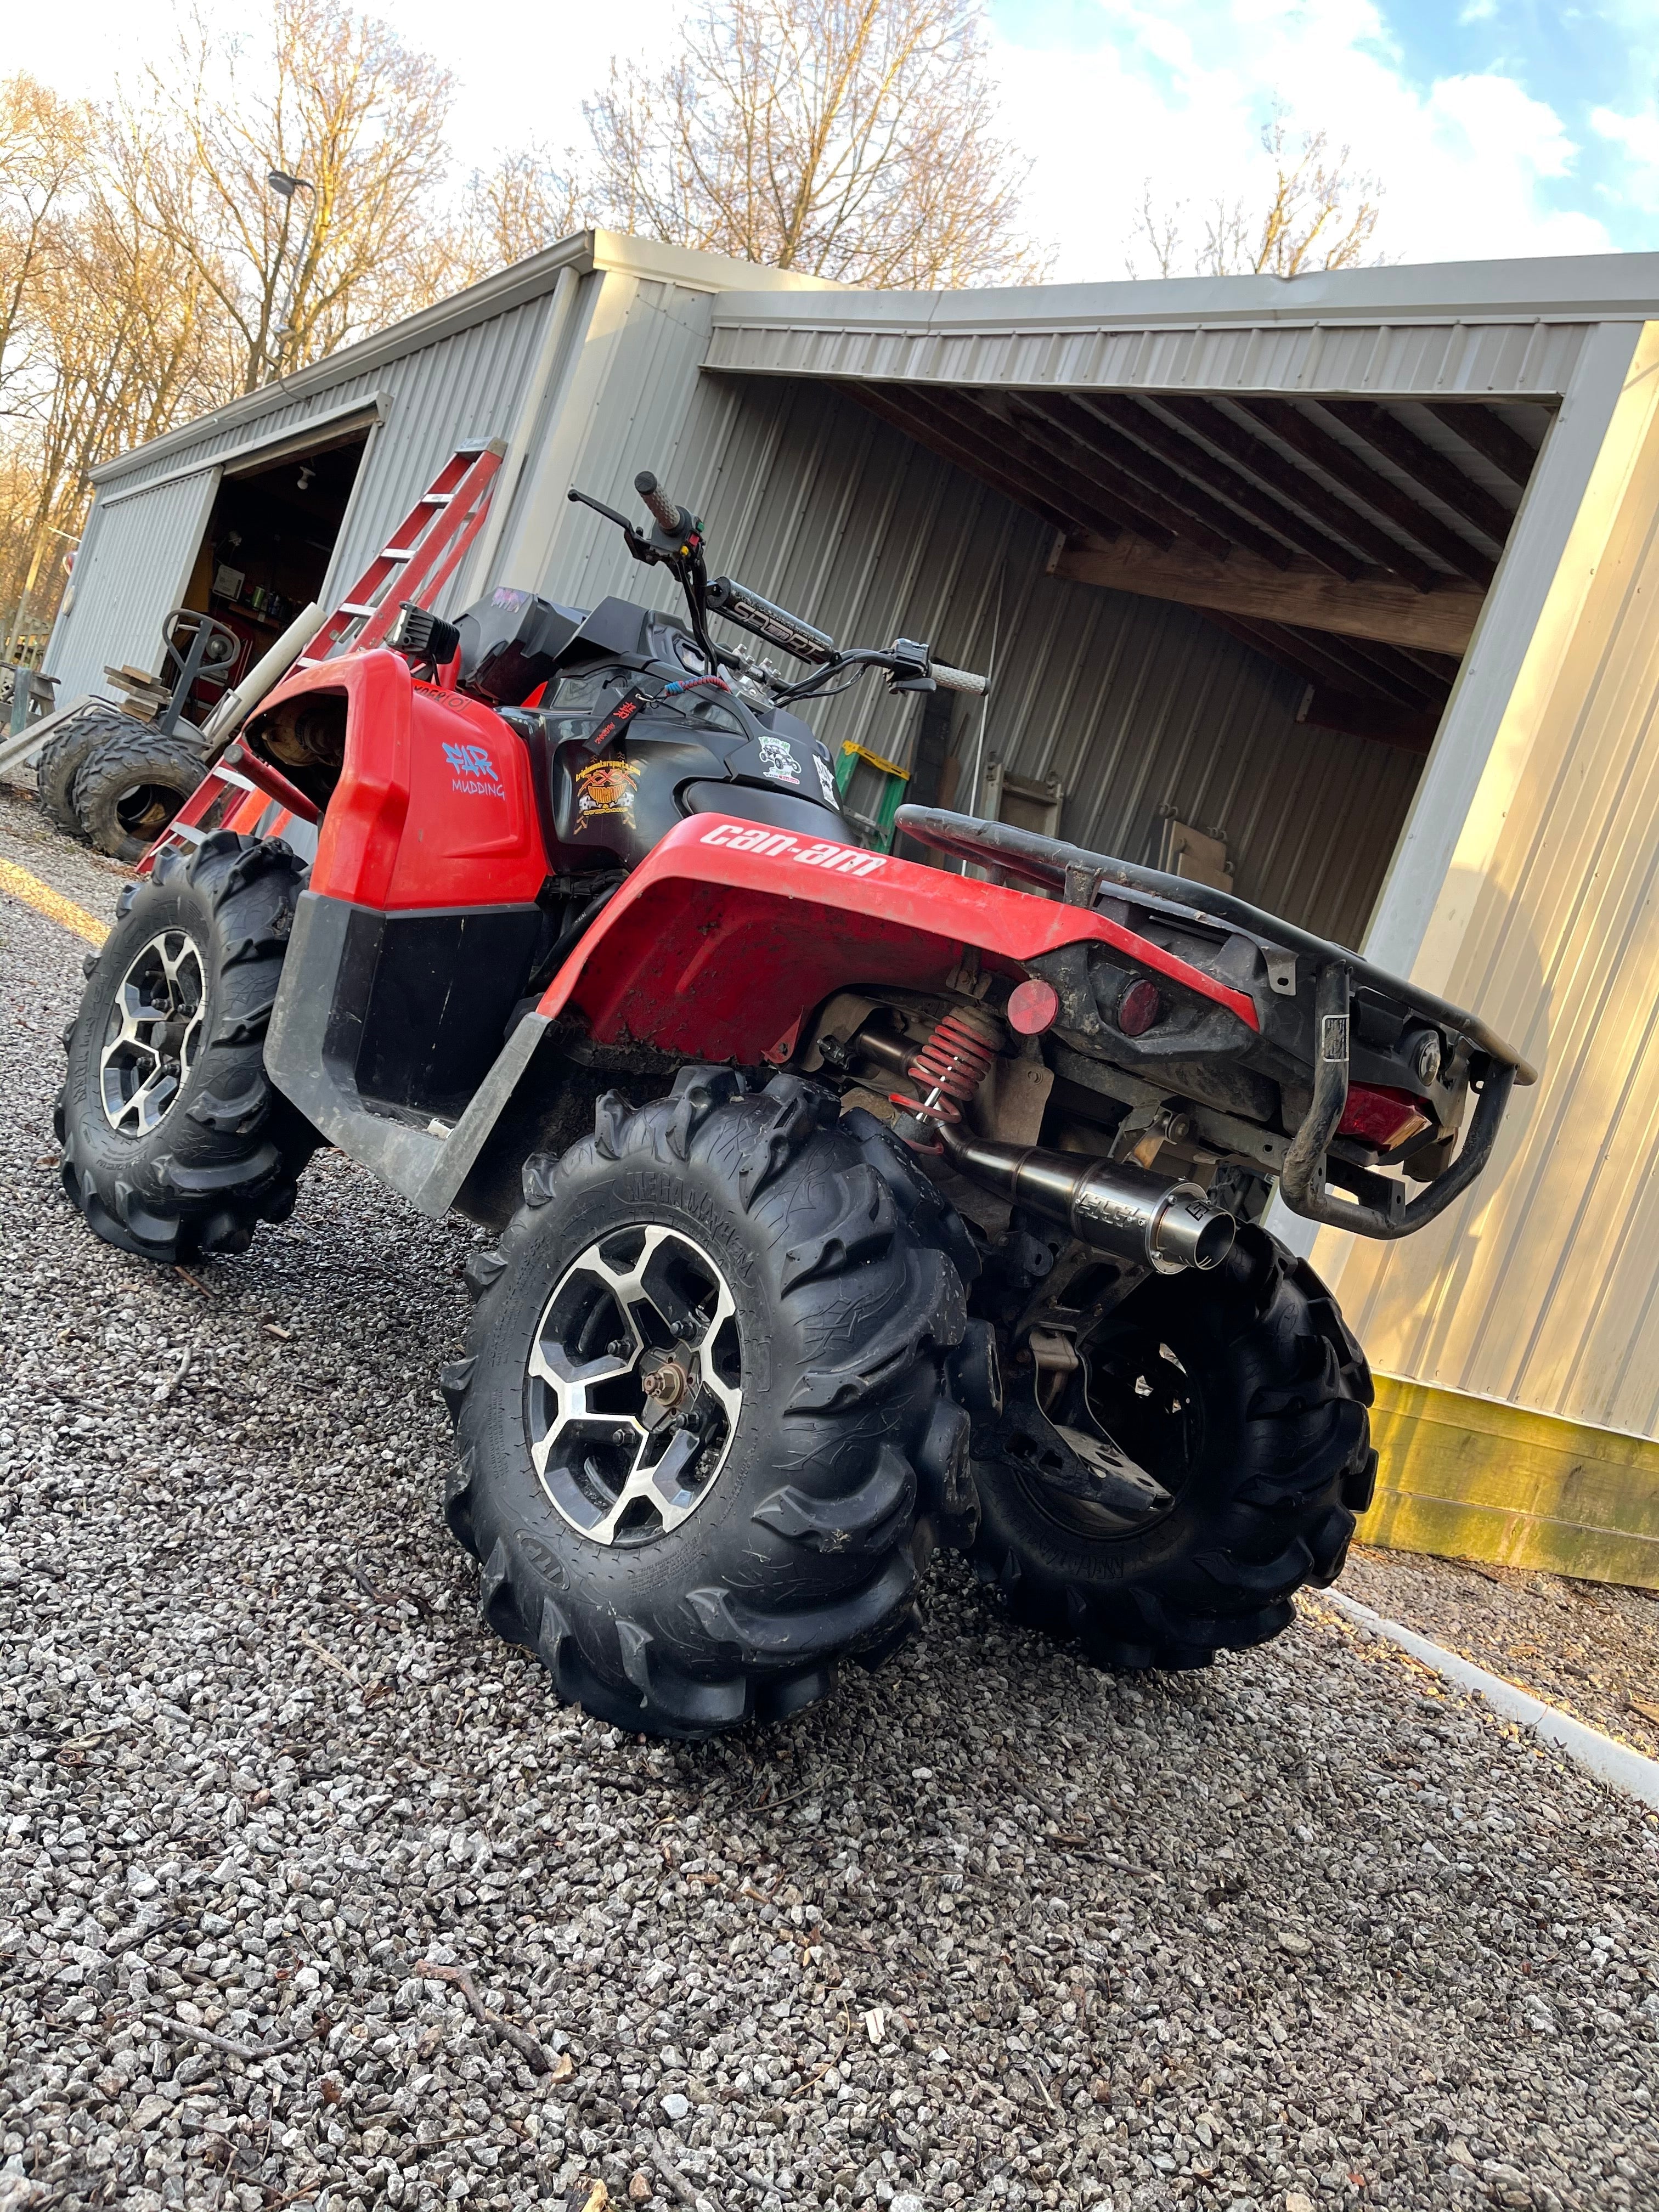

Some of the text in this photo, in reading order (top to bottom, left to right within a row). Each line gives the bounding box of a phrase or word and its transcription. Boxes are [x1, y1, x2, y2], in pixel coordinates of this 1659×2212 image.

[734, 601, 825, 656] SPORT
[442, 742, 498, 782] FAR
[452, 778, 506, 801] MUDDING
[699, 824, 887, 877] can-am
[526, 1543, 562, 1581] ITP
